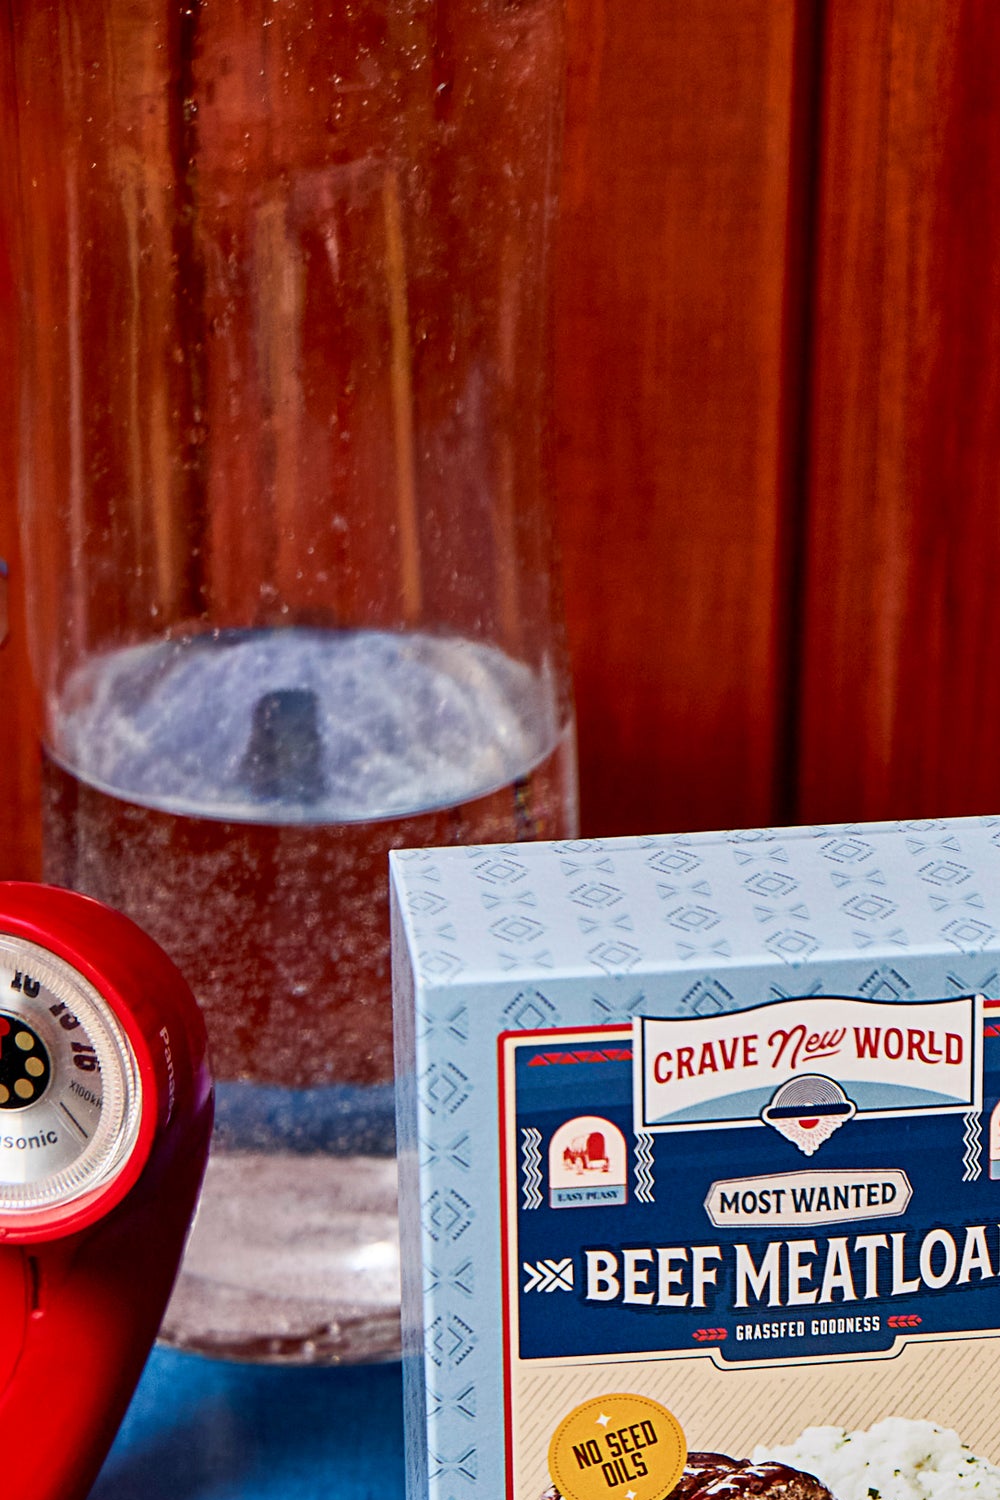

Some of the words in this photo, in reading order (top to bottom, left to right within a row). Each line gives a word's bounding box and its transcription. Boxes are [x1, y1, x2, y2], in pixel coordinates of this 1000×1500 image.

[653, 1034, 759, 1085] CRAVE
[768, 1024, 847, 1069] New
[854, 1027, 964, 1065] WORLD
[0, 1129, 58, 1150] sonic
[720, 1189, 786, 1215] MOST
[792, 1182, 897, 1213] WANTED
[584, 1245, 723, 1308] BEEF
[735, 1321, 805, 1341] GRASSFED
[811, 1315, 881, 1336] GOODNESS
[572, 1439, 603, 1470] NO
[605, 1420, 658, 1458] SEED
[601, 1452, 648, 1488] OILS
